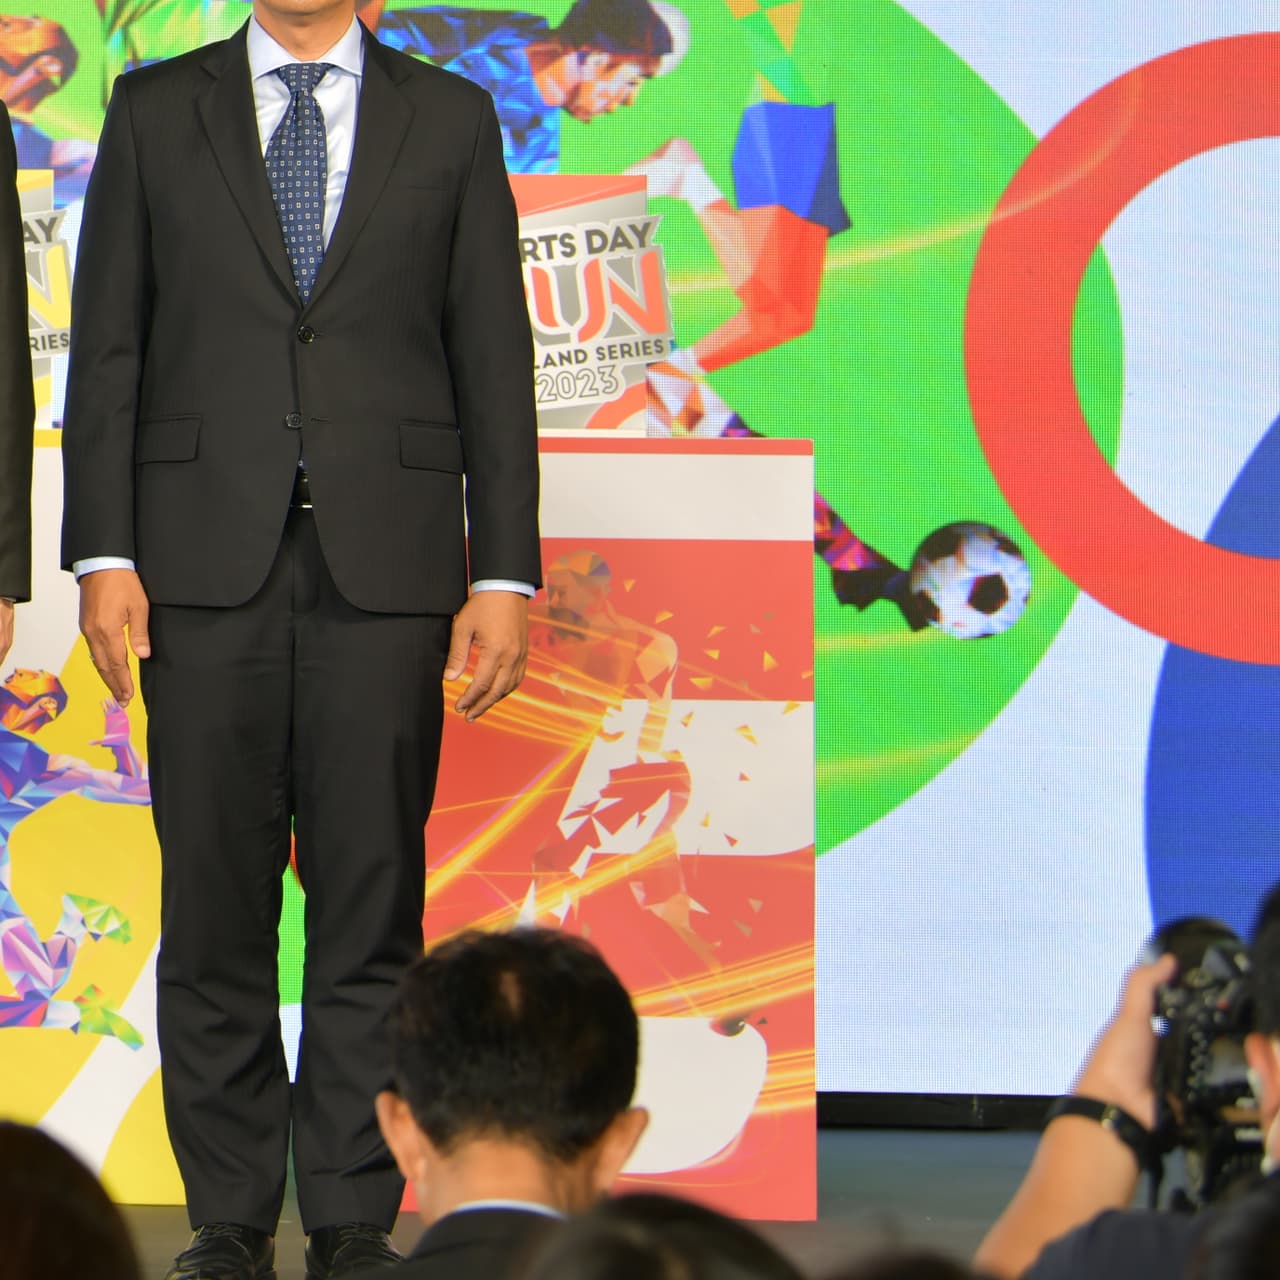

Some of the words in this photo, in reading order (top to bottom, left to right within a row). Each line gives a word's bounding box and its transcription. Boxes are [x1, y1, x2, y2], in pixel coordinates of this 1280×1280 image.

[24, 216, 59, 245] AY
[519, 232, 577, 264] RTS
[585, 221, 652, 255] DAY
[525, 249, 669, 343] UN
[30, 332, 70, 353] RIES
[596, 338, 664, 362] SERIES
[535, 364, 619, 404] 2023
